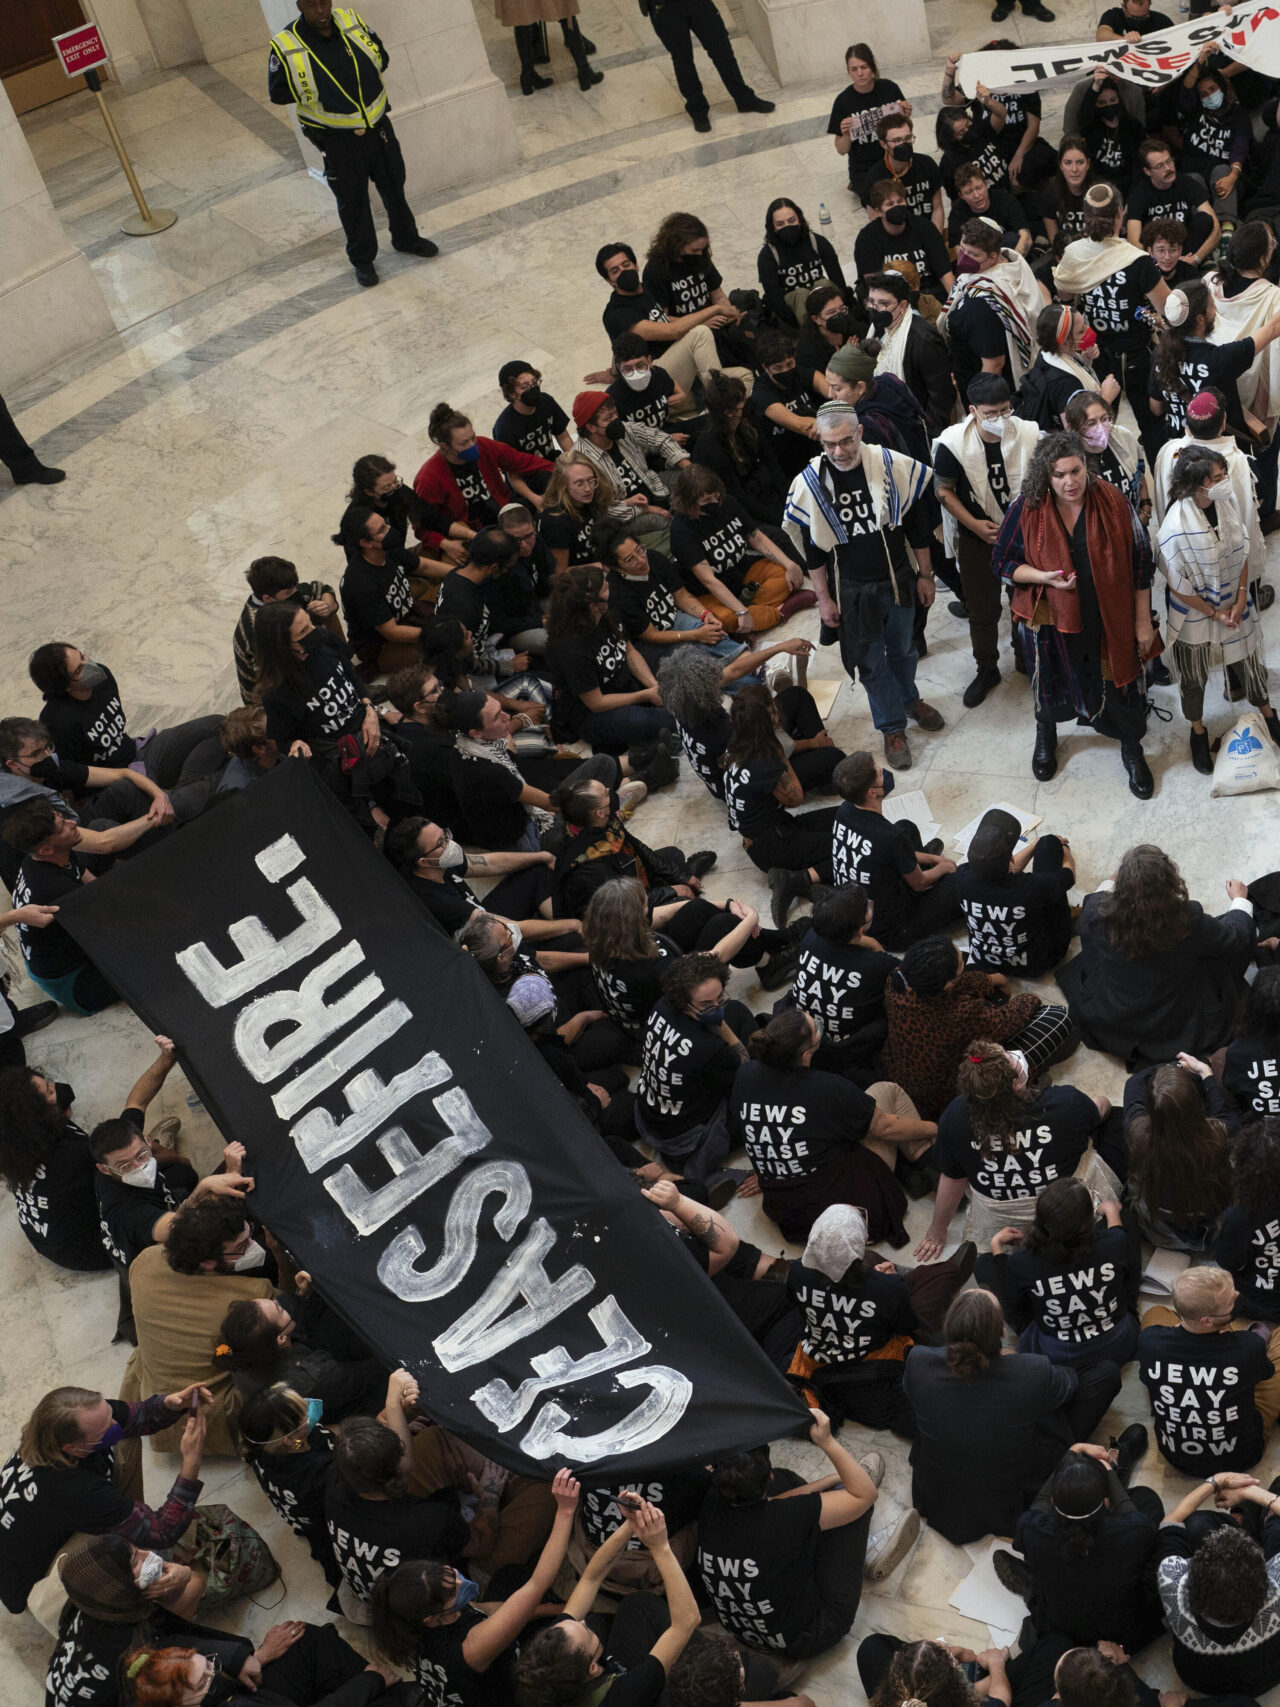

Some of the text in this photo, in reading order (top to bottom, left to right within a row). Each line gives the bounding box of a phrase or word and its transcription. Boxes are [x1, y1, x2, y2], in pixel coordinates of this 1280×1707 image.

[62, 36, 98, 56] EMERGENCY
[66, 43, 100, 63] EXIT ONLY
[1191, 128, 1229, 159] NAME
[1149, 201, 1188, 215] NOT IN
[672, 276, 694, 291] NOT
[681, 282, 707, 301] OUR
[702, 517, 742, 551] NOT IN
[714, 534, 745, 562] OUR
[307, 677, 337, 711] NOT
[324, 677, 354, 716] OUR
[87, 697, 120, 740] NOT IN
[100, 713, 125, 747] OUR
[960, 899, 1025, 921] JEWS
[968, 915, 1016, 935] SAY
[797, 950, 861, 988] JEWS
[797, 971, 847, 1005] SAY
[648, 1011, 692, 1059] JEWS
[645, 1031, 677, 1067] SAY
[643, 1046, 683, 1085] EASE
[740, 1103, 806, 1124] JEWS
[745, 1125, 794, 1144] SAY
[745, 1141, 809, 1159] CEASE
[984, 1148, 1043, 1172] SAY
[756, 1160, 803, 1175] FIRE
[977, 1164, 1058, 1186] CEASE
[1032, 1263, 1115, 1304] JEWS
[797, 1286, 876, 1317] JEWS
[1043, 1295, 1117, 1331] CEASE
[1046, 1286, 1107, 1317] SAY
[805, 1307, 862, 1334] SAY
[1058, 1313, 1114, 1342] FIRE
[1148, 1361, 1238, 1386] JEWS
[1160, 1385, 1226, 1408] SAY
[1154, 1401, 1238, 1424] CEASE
[1162, 1431, 1237, 1455] NOW
[1166, 1421, 1225, 1440] FIRE
[702, 1574, 751, 1600] SAY
